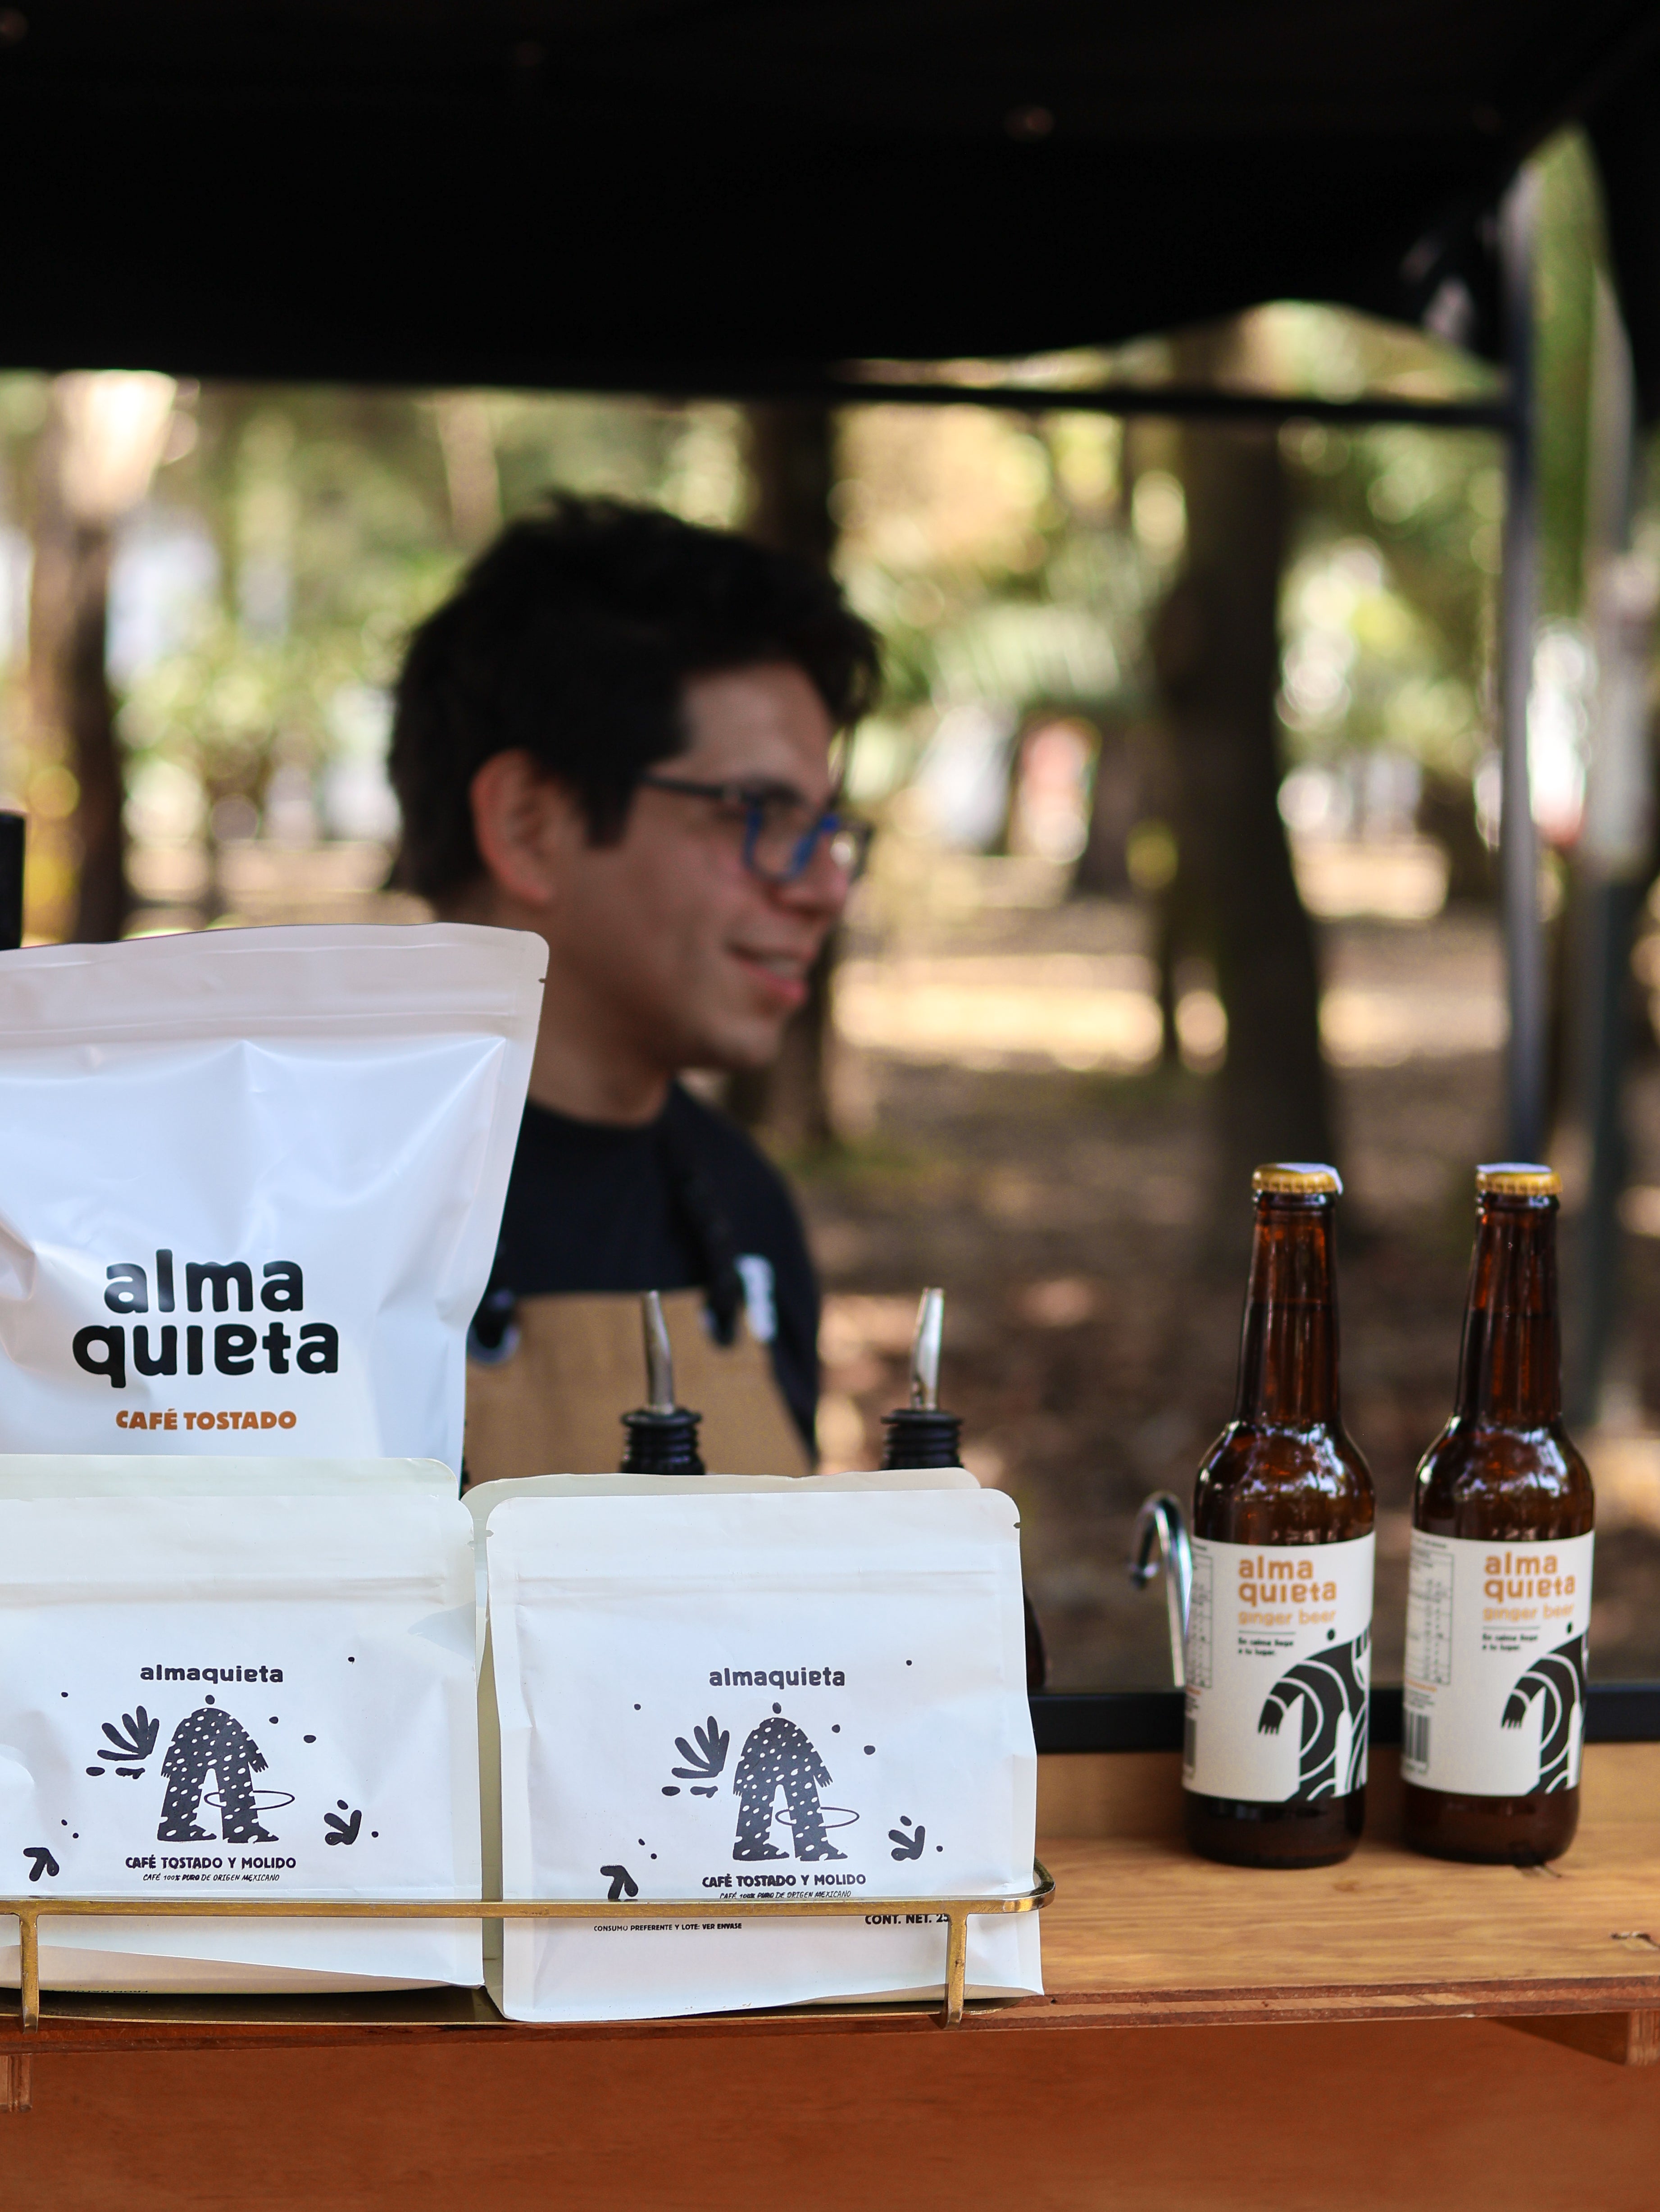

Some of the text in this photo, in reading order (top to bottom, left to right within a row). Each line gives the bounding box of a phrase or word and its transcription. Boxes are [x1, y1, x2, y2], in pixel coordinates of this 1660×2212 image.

[104, 1249, 303, 1314] alma
[116, 1409, 296, 1430] CAFÉ TOSTADO
[1239, 1555, 1313, 1579] alma
[1485, 1551, 1557, 1575] alma
[1238, 1609, 1336, 1626] ginger beer
[1483, 1604, 1574, 1622] ginger beer
[141, 1665, 283, 1684] almaquieta
[709, 1667, 845, 1689] almaquieta
[126, 1855, 296, 1870] CAFÉ TOSTADO Y MOLIDO
[143, 1872, 160, 1881] CAFÉ
[702, 1874, 866, 1888] CAFÉ TOSTADO Y MOLIDO
[865, 1915, 901, 1925] CONT.
[906, 1915, 932, 1924] NET.
